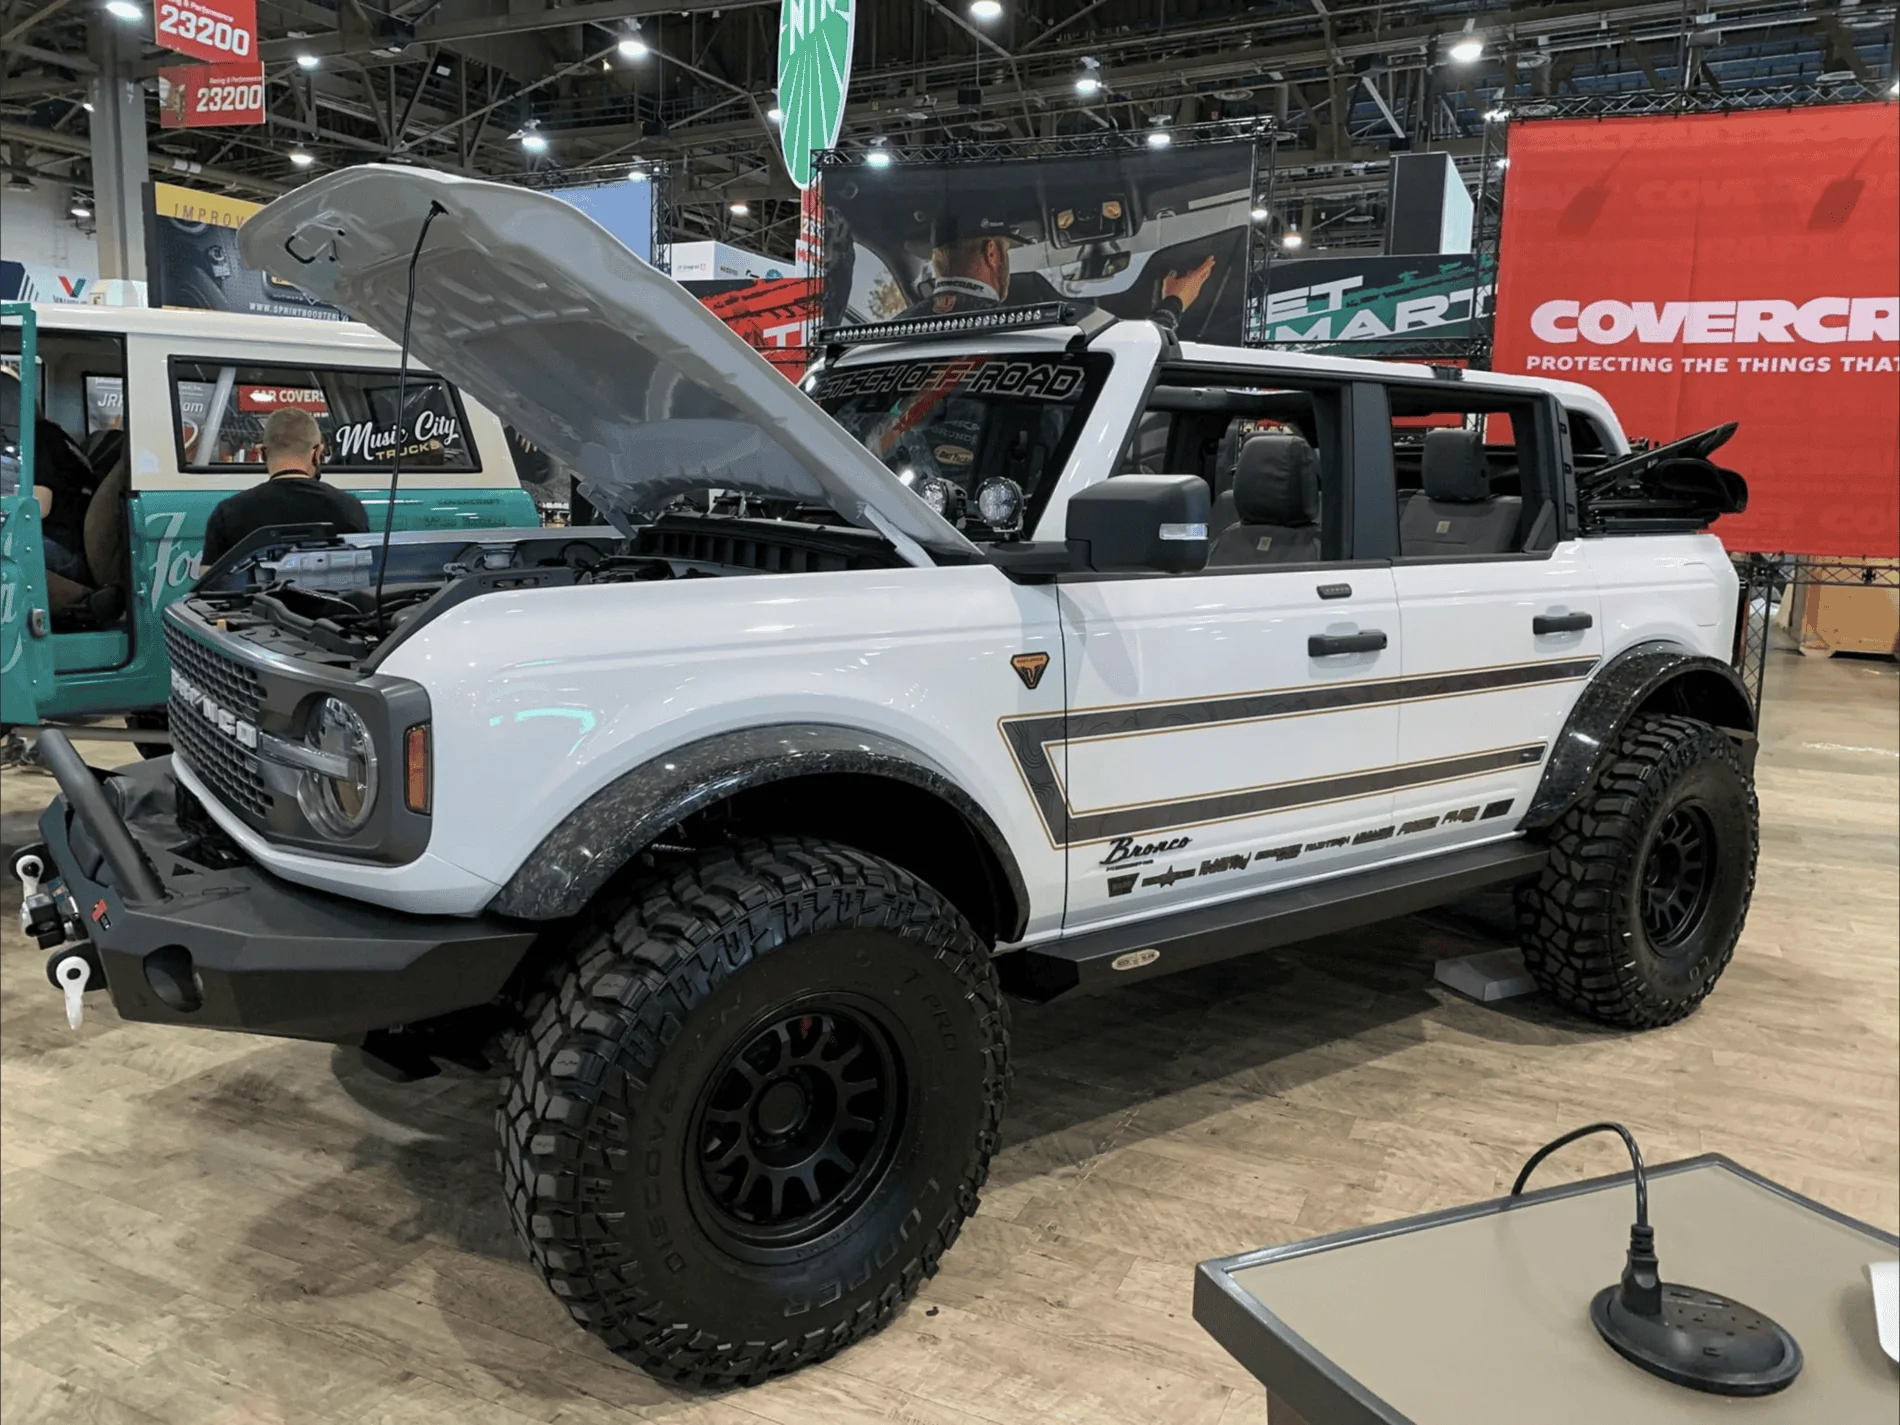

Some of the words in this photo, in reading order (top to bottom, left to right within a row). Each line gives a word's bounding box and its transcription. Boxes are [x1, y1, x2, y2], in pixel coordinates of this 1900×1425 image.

[160, 4, 250, 56] 23200
[196, 85, 262, 113] 23200
[1526, 355, 1673, 373] PROTECTING
[1681, 357, 1729, 373] THE
[1737, 356, 1832, 373] THINGS
[897, 361, 1085, 400] OFF-ROAD
[336, 421, 409, 461] Music
[415, 411, 460, 445] City
[375, 439, 443, 461] TRUCKS
[1098, 835, 1193, 865] Bronco
